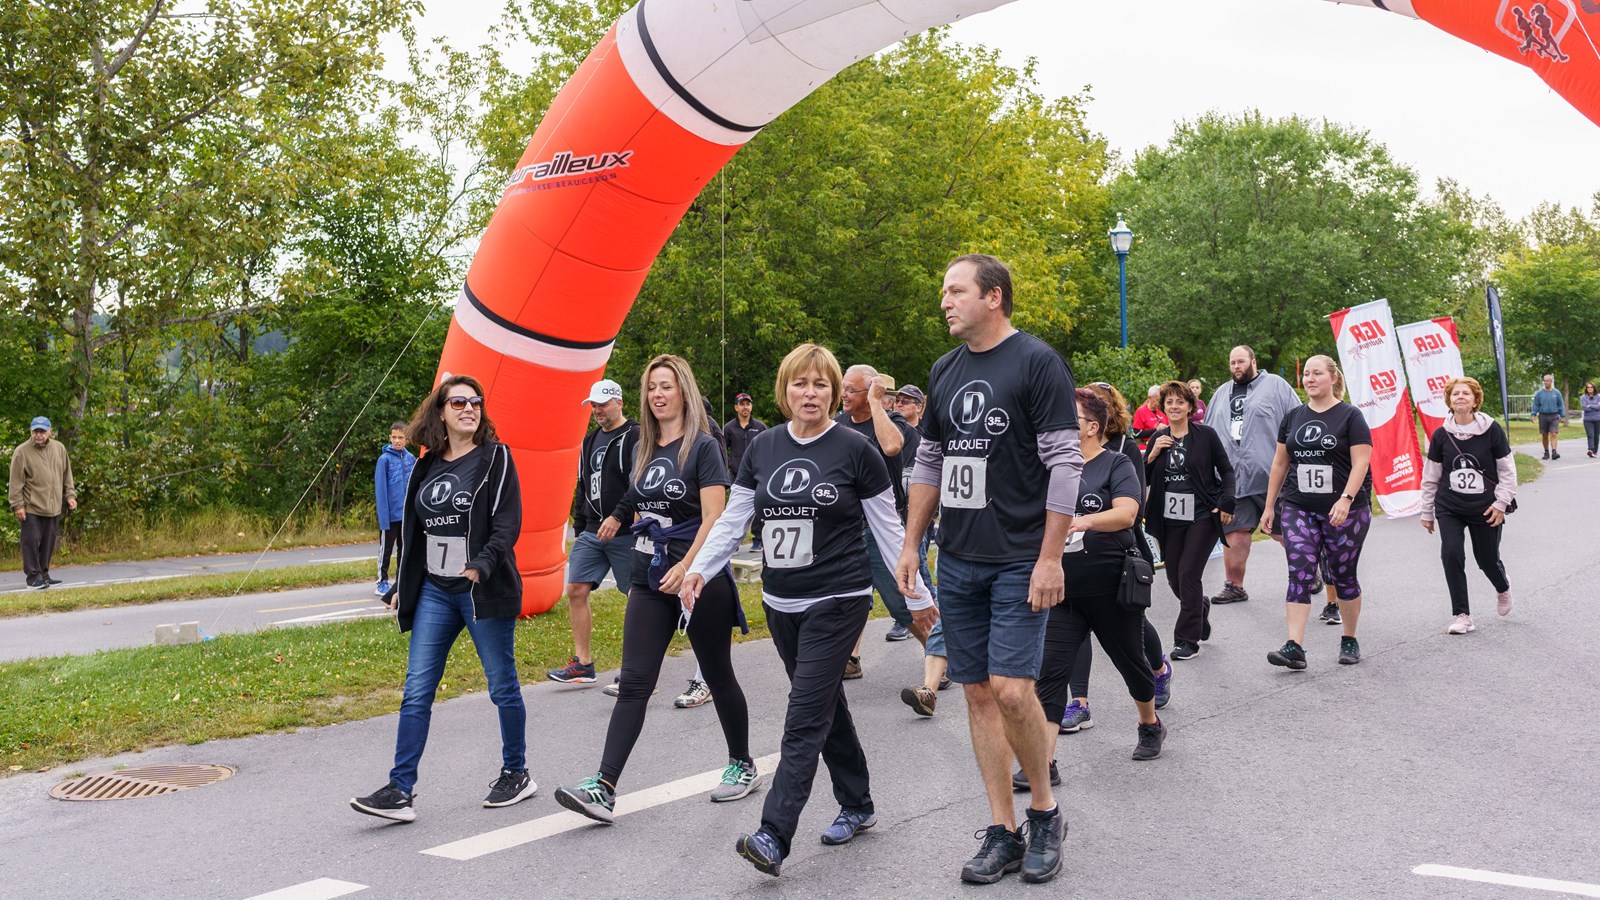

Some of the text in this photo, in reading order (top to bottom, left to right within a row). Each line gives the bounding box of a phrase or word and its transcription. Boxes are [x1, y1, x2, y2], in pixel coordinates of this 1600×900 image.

[947, 439, 991, 451] DUQUET
[947, 464, 974, 500] 49
[1306, 469, 1324, 488] 15
[1457, 472, 1477, 490] 32
[763, 506, 818, 517] DUQUET
[1169, 496, 1186, 516] 21
[425, 515, 461, 528] DUQUET
[771, 527, 801, 560] 27
[437, 542, 449, 570] 7
